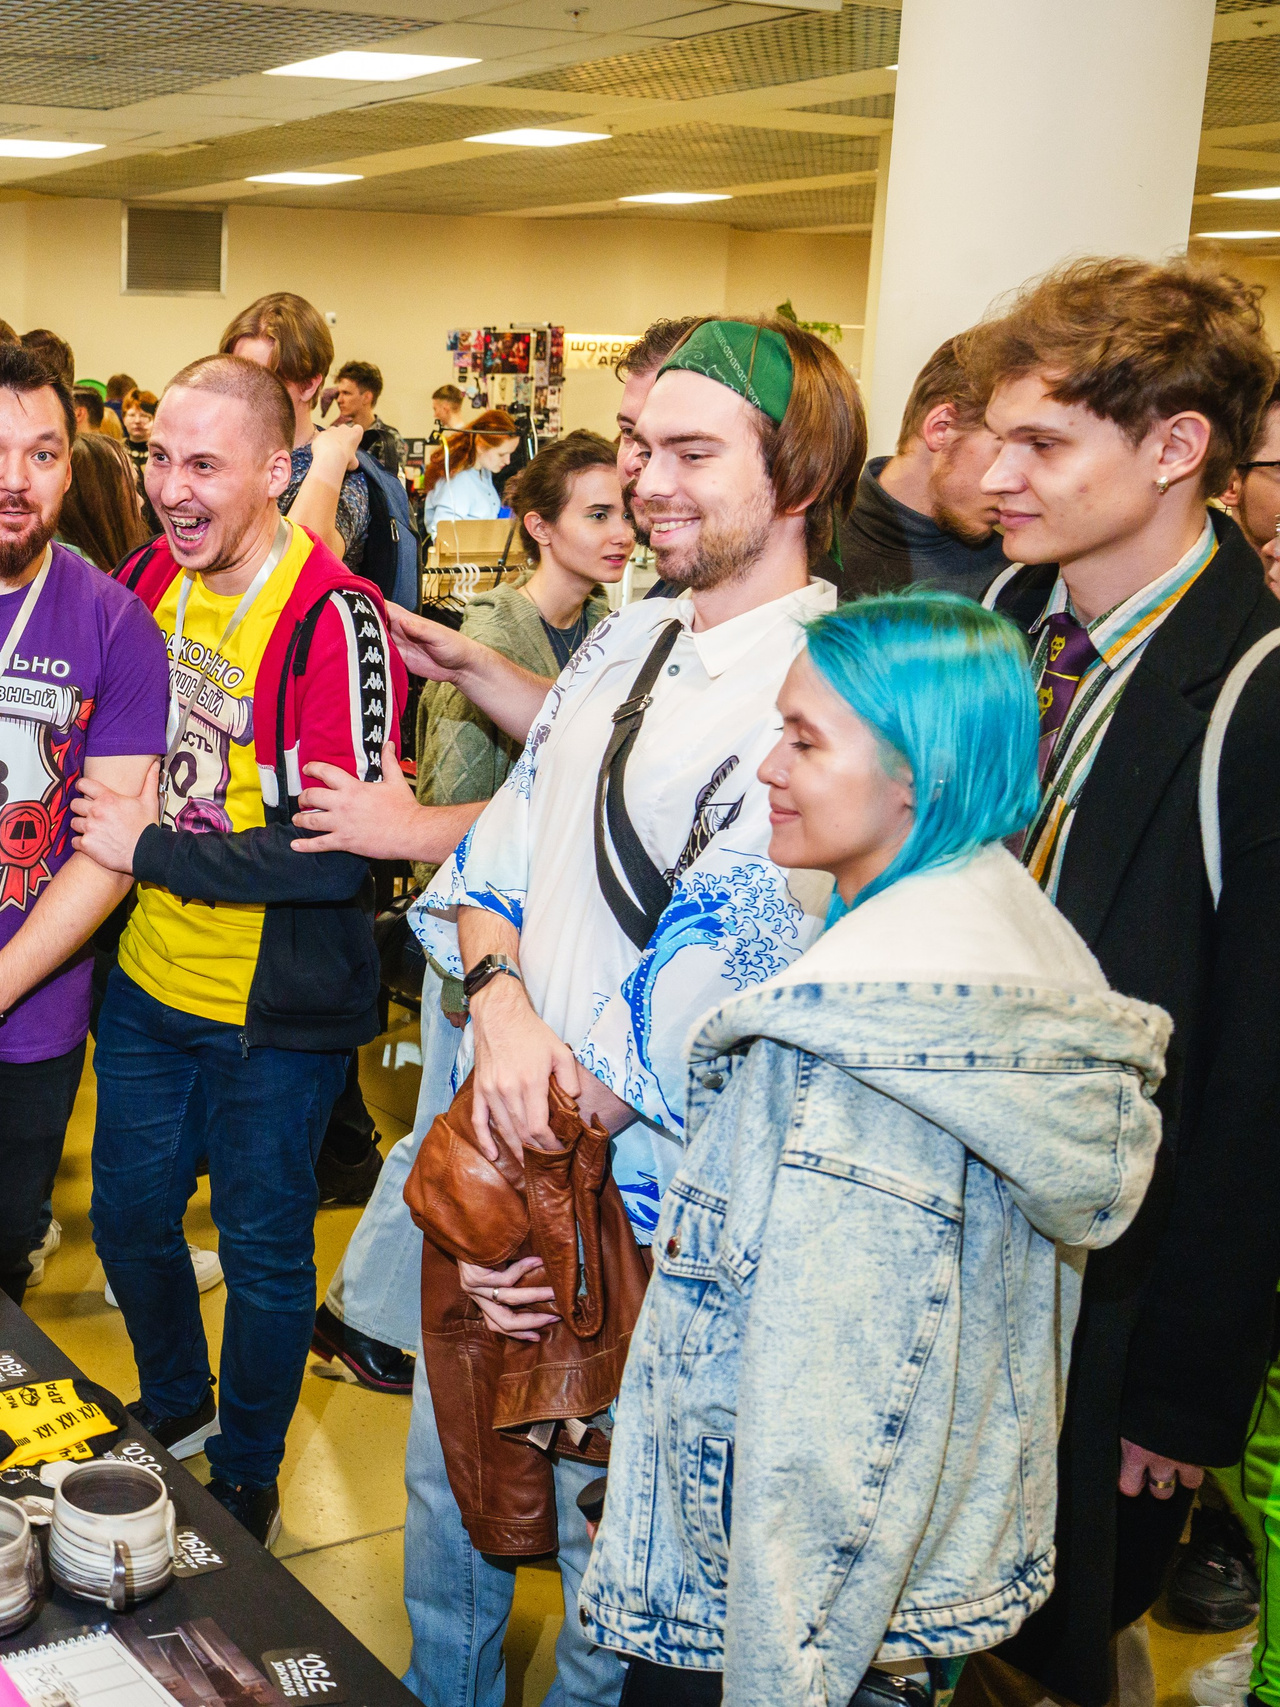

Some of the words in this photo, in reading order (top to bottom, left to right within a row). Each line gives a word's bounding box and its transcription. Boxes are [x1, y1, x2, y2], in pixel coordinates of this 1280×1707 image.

[597, 356, 620, 366] АР
[160, 629, 245, 690] АКОННО
[182, 731, 214, 754] СТЬ
